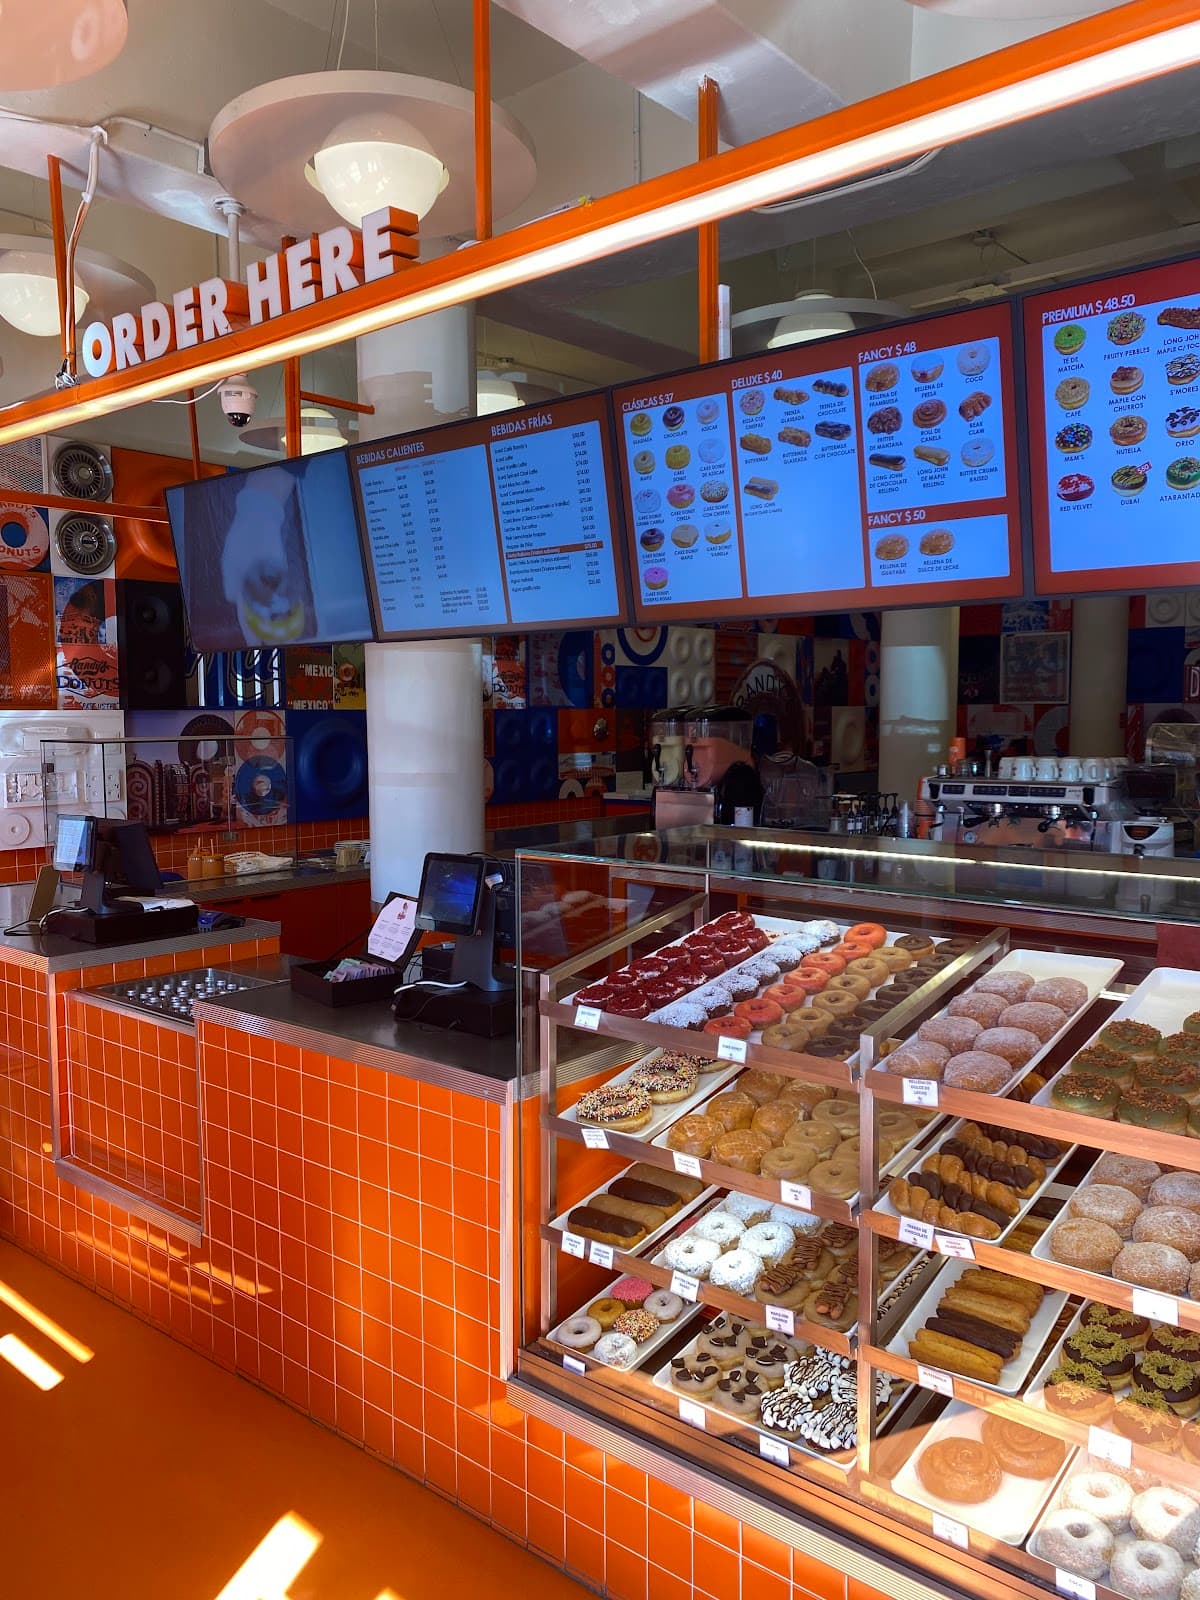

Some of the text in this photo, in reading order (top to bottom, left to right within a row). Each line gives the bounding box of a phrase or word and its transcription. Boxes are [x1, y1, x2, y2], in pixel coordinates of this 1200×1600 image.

[82, 206, 419, 377] ORDER HERE
[1042, 303, 1093, 324] PREMIUM
[1104, 293, 1135, 311] 48.50
[1164, 336, 1183, 346] LONG
[858, 346, 893, 363] FANCY
[904, 341, 917, 353] 48
[1058, 363, 1085, 373] MATCHA
[731, 374, 762, 390] DELUXE
[771, 370, 783, 380] 40
[965, 376, 984, 384] COCO
[622, 396, 658, 412] CLÁSICAS
[1108, 397, 1131, 406] MAPLE
[1113, 403, 1144, 413] CHURROS
[491, 412, 552, 436] BEBIDAS FRÍAS
[1116, 447, 1142, 455] NUTELLA
[1175, 440, 1195, 448] OREO
[356, 442, 424, 464] BEBIDAS CALIENTES
[868, 511, 903, 527] FANCY
[913, 509, 926, 521] 50
